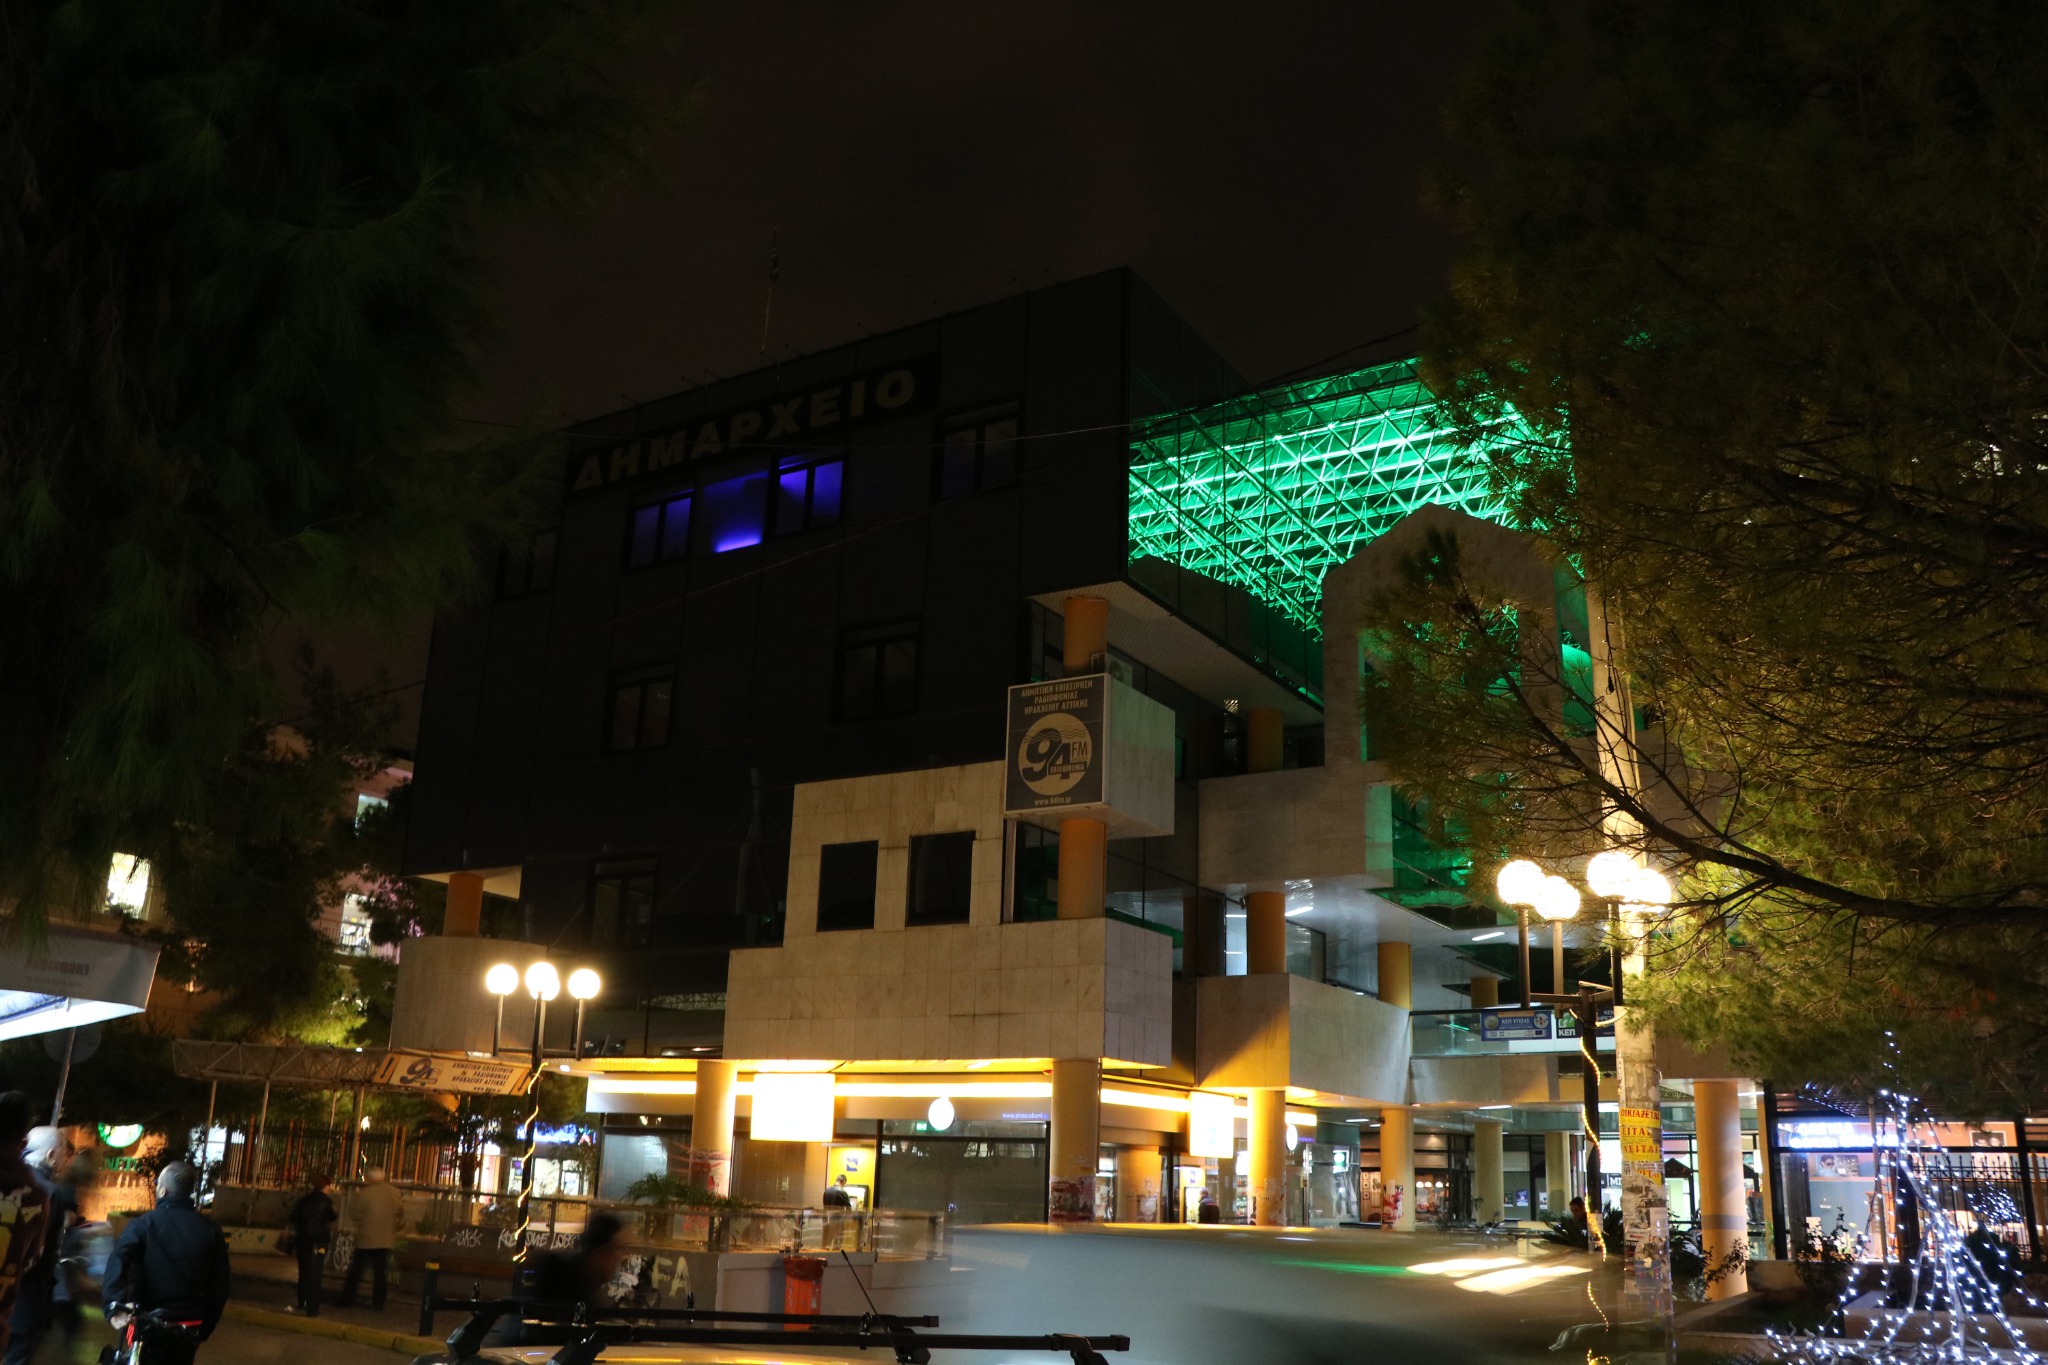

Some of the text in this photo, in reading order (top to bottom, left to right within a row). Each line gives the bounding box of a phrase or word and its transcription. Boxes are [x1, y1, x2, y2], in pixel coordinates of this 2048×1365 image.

[574, 369, 916, 491] ΔΗΜΑΡΧΕΙΟ
[1021, 680, 1093, 697] ΔΗΜΟΤΙΚΗ ΕΠΙΧΕΙΡΗΣΗ
[1034, 690, 1078, 704] ΡΑΔΙΟΦΩΝΙΑΣ
[1024, 699, 1089, 715] ΗΡΑΚΛΕΙΟΥ ΑΤΤΙΚΗΣ
[1022, 728, 1088, 782] 94 FM
[1558, 1028, 1576, 1036] ΚΕΠ
